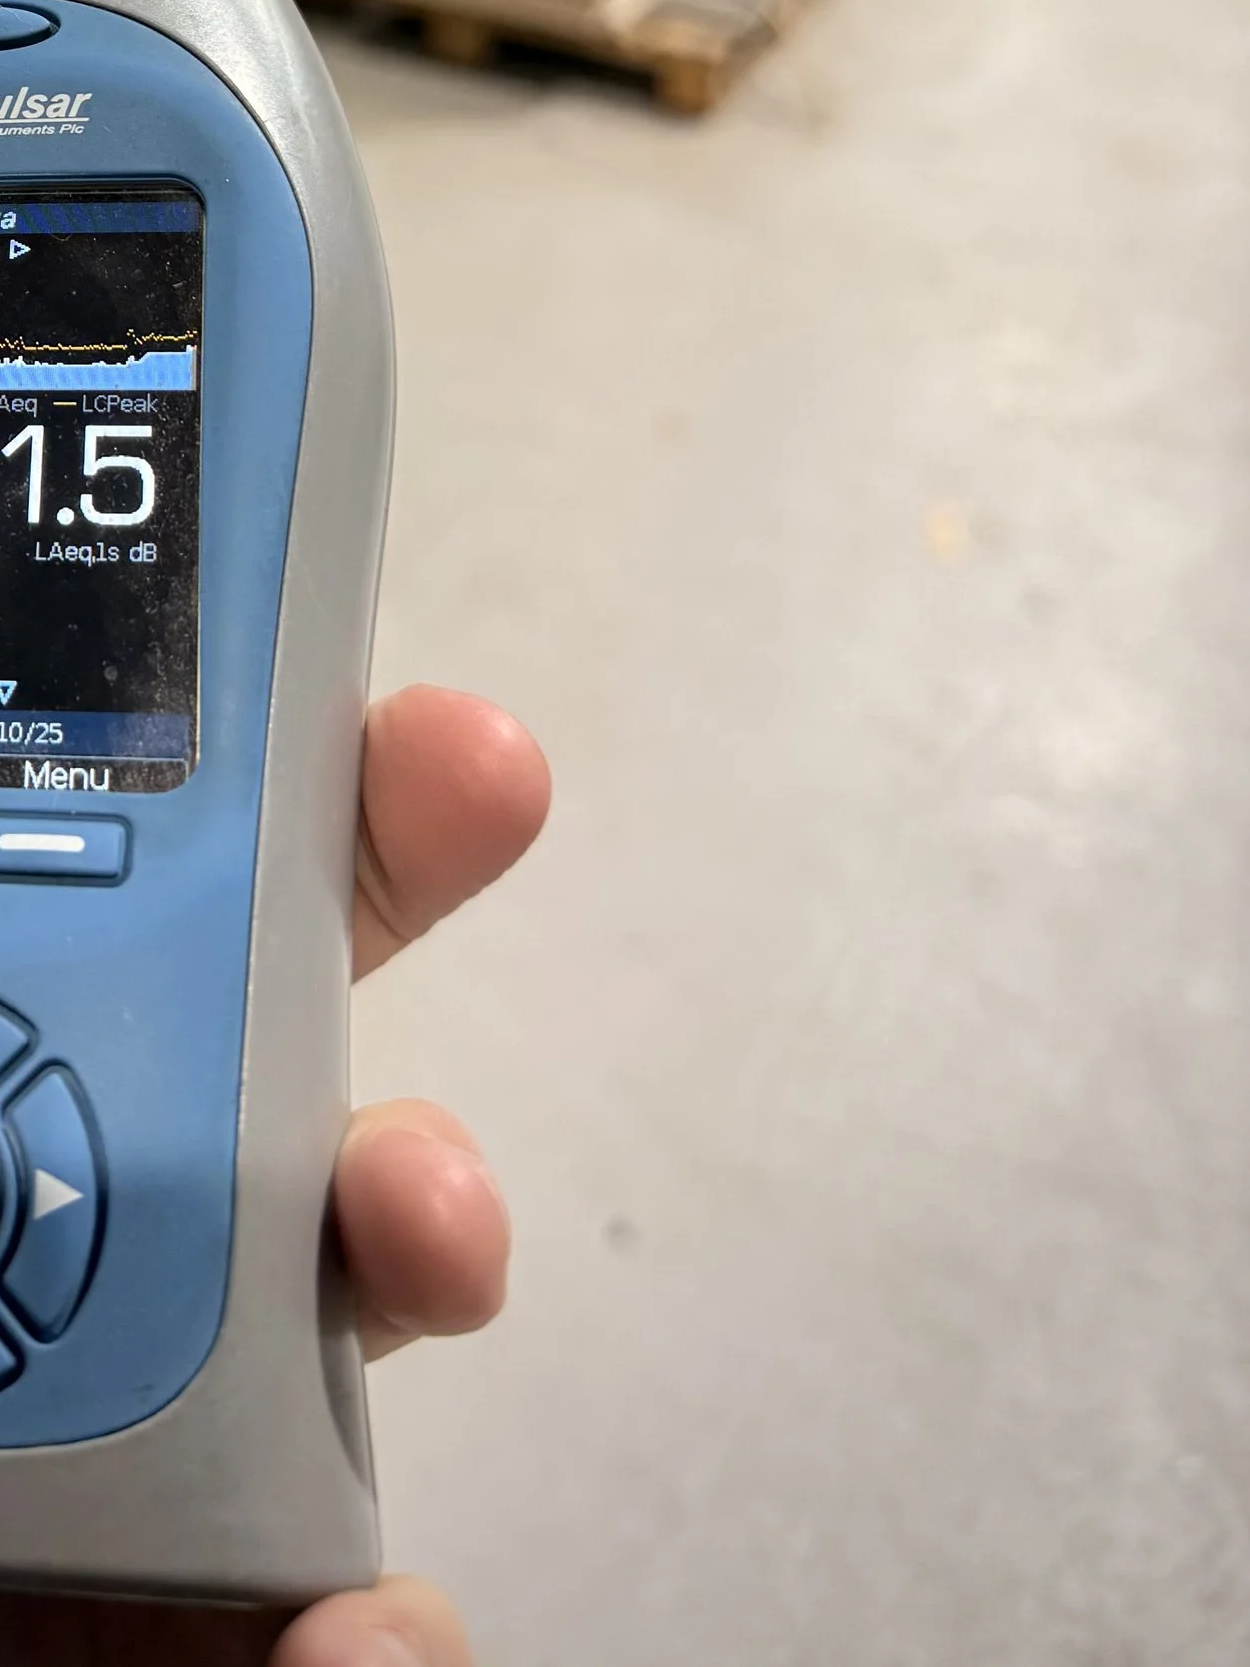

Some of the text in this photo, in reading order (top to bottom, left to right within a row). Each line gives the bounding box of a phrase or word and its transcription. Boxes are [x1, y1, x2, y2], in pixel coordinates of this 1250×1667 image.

[59, 123, 85, 135] Plc
[82, 395, 158, 413] LCPeak
[129, 543, 157, 563] dB
[23, 761, 110, 791] Menu
